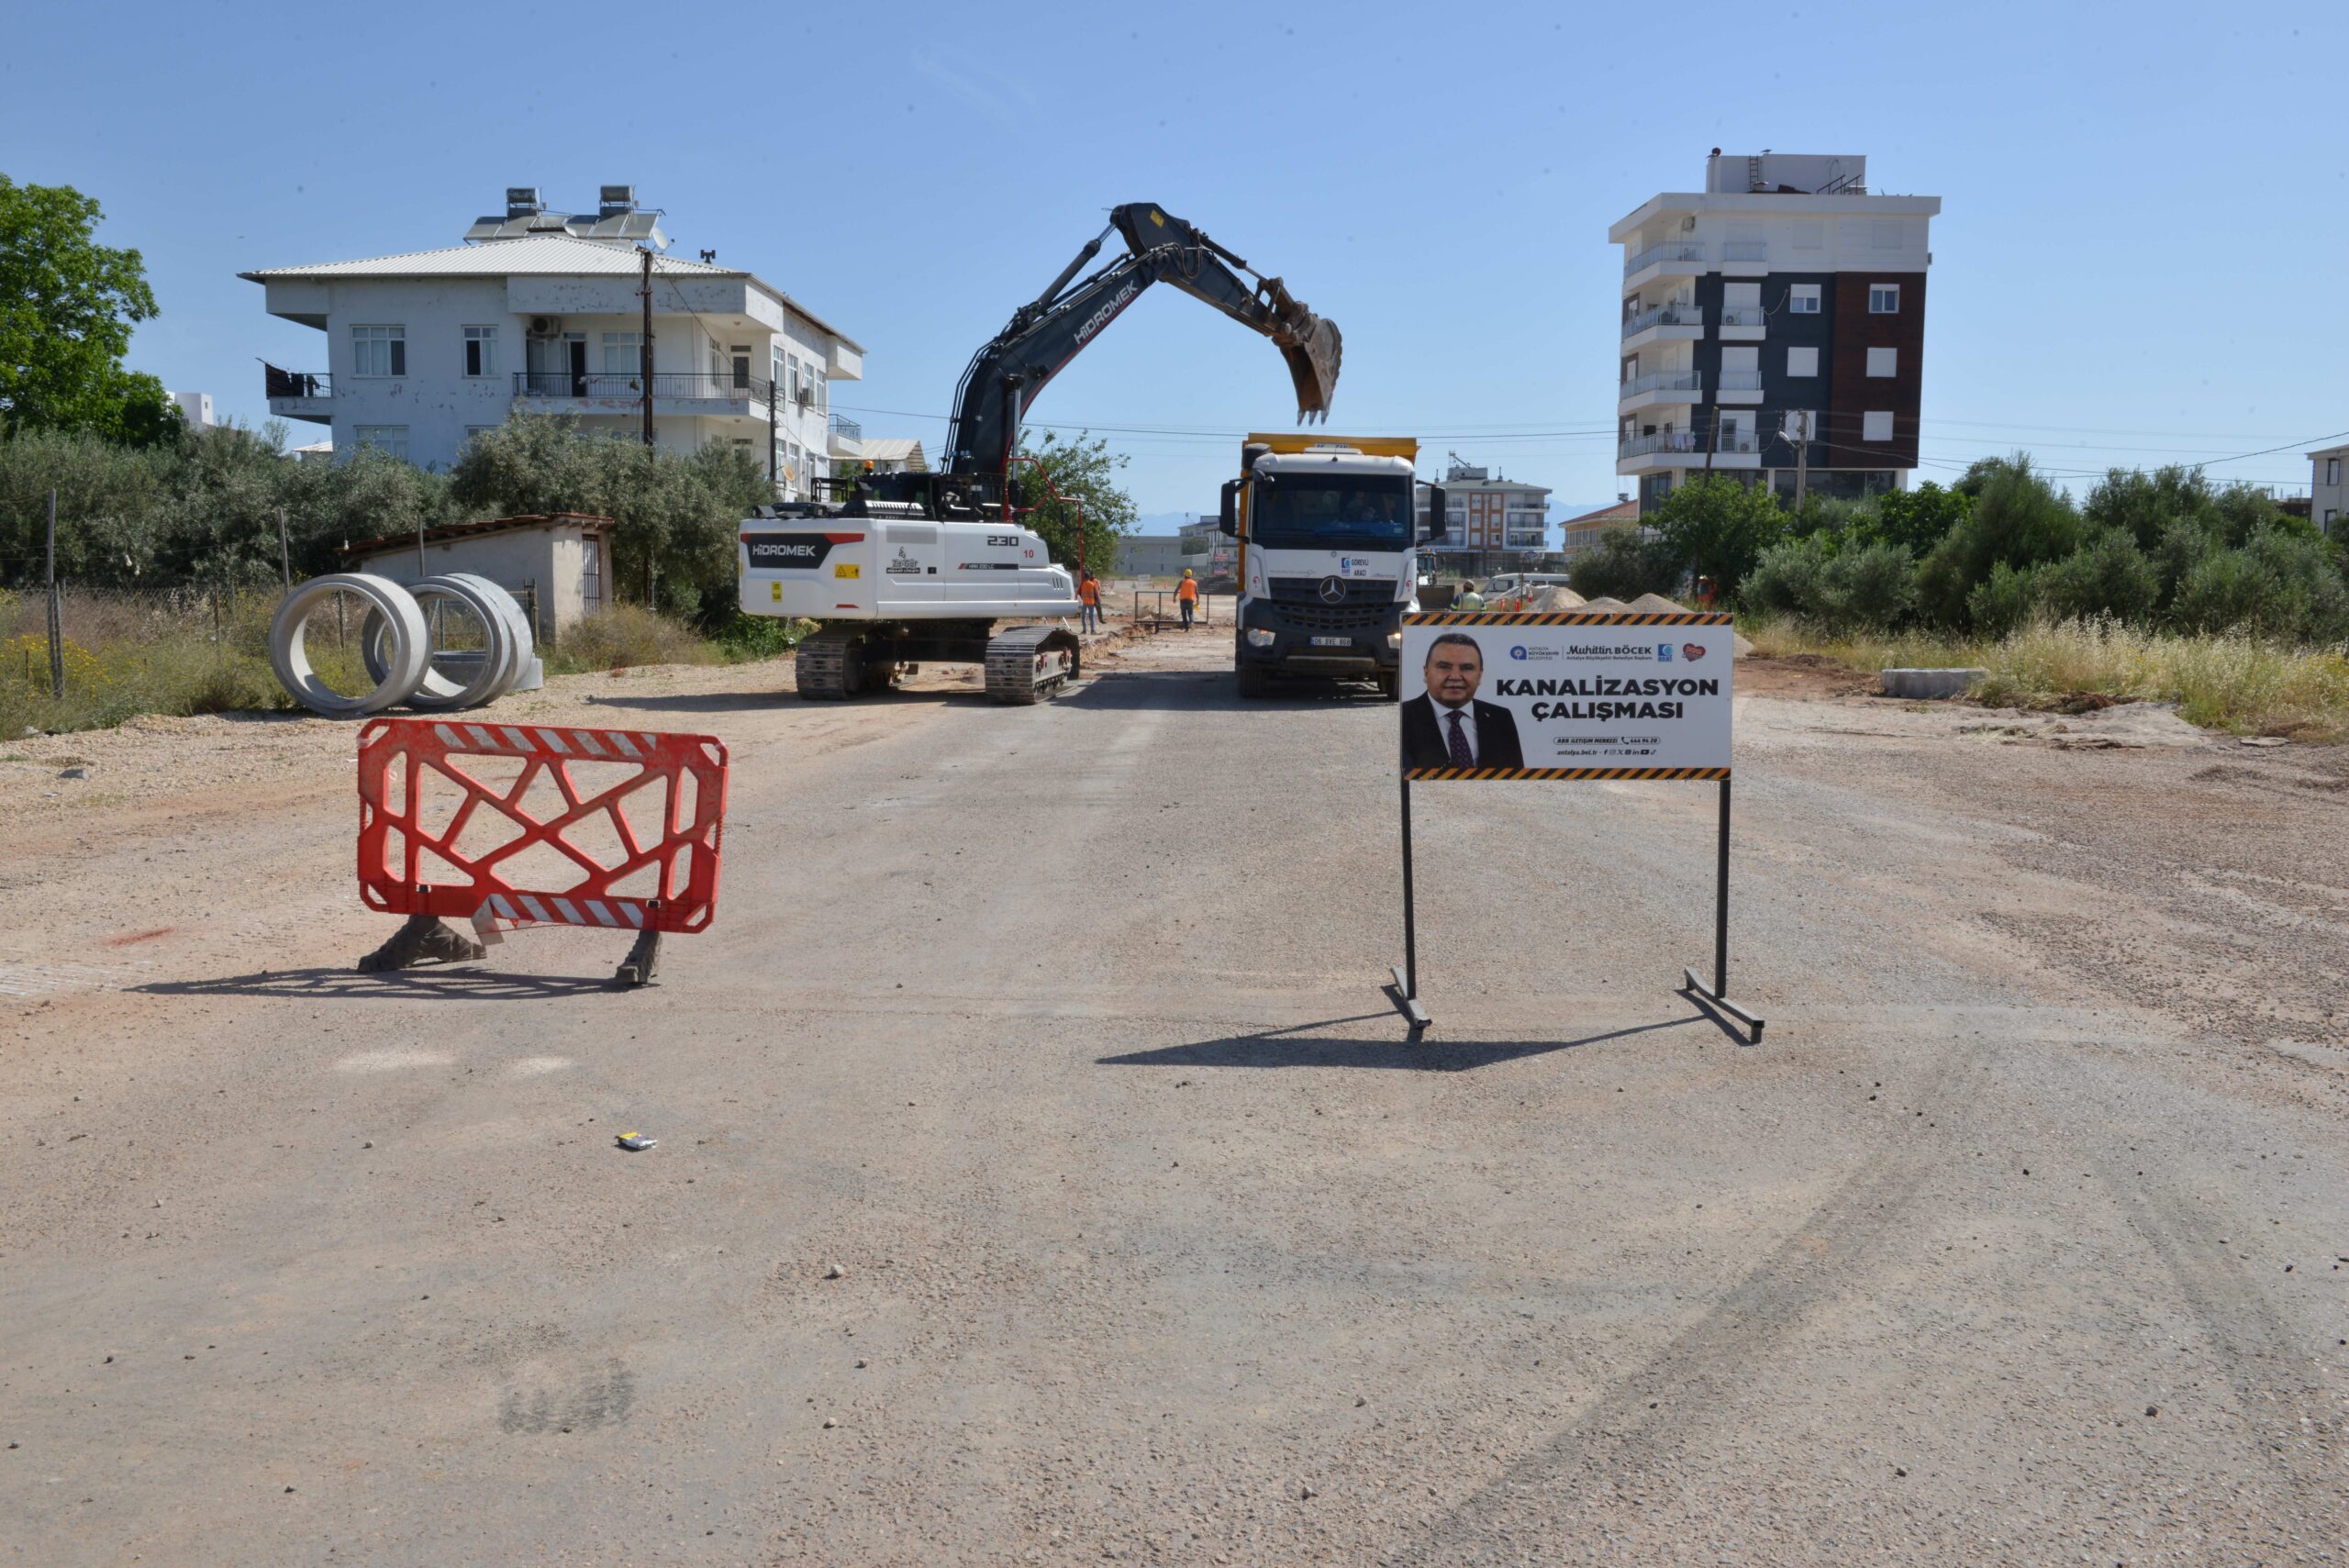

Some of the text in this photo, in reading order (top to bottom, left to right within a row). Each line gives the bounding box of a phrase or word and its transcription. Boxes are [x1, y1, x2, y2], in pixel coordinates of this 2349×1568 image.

[986, 536, 1019, 546] 230
[1023, 550, 1034, 558] 10
[1566, 644, 1652, 655] Muhittin BÖCEK
[1497, 675, 1719, 695] KANALİZASYON
[1531, 702, 1683, 722] ÇALIŞMASI
